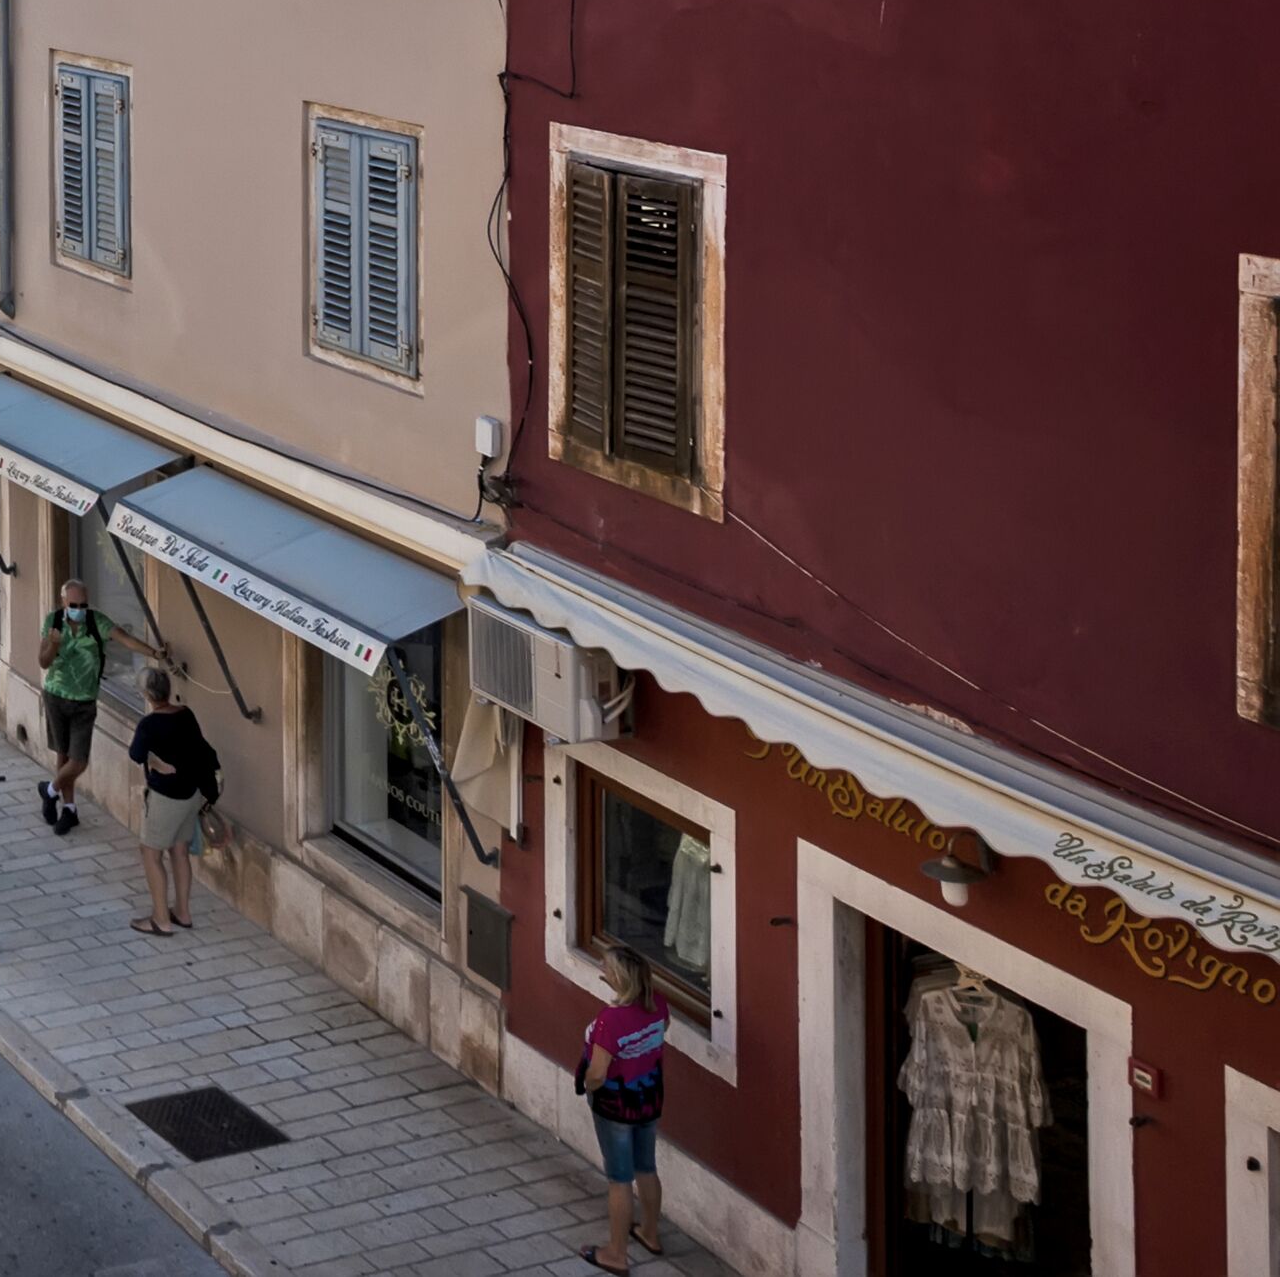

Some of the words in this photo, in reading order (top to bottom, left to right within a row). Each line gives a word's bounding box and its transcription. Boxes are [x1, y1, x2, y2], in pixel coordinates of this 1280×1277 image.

[116, 512, 159, 548] Boutique
[231, 577, 271, 611] Luxury
[269, 599, 308, 629] Italian
[306, 617, 351, 652] Fashion
[1052, 831, 1090, 866] Un
[1083, 855, 1176, 901] Saluto
[1180, 894, 1216, 917] da
[1043, 882, 1088, 921] da
[1080, 897, 1277, 1005] Rovigno
